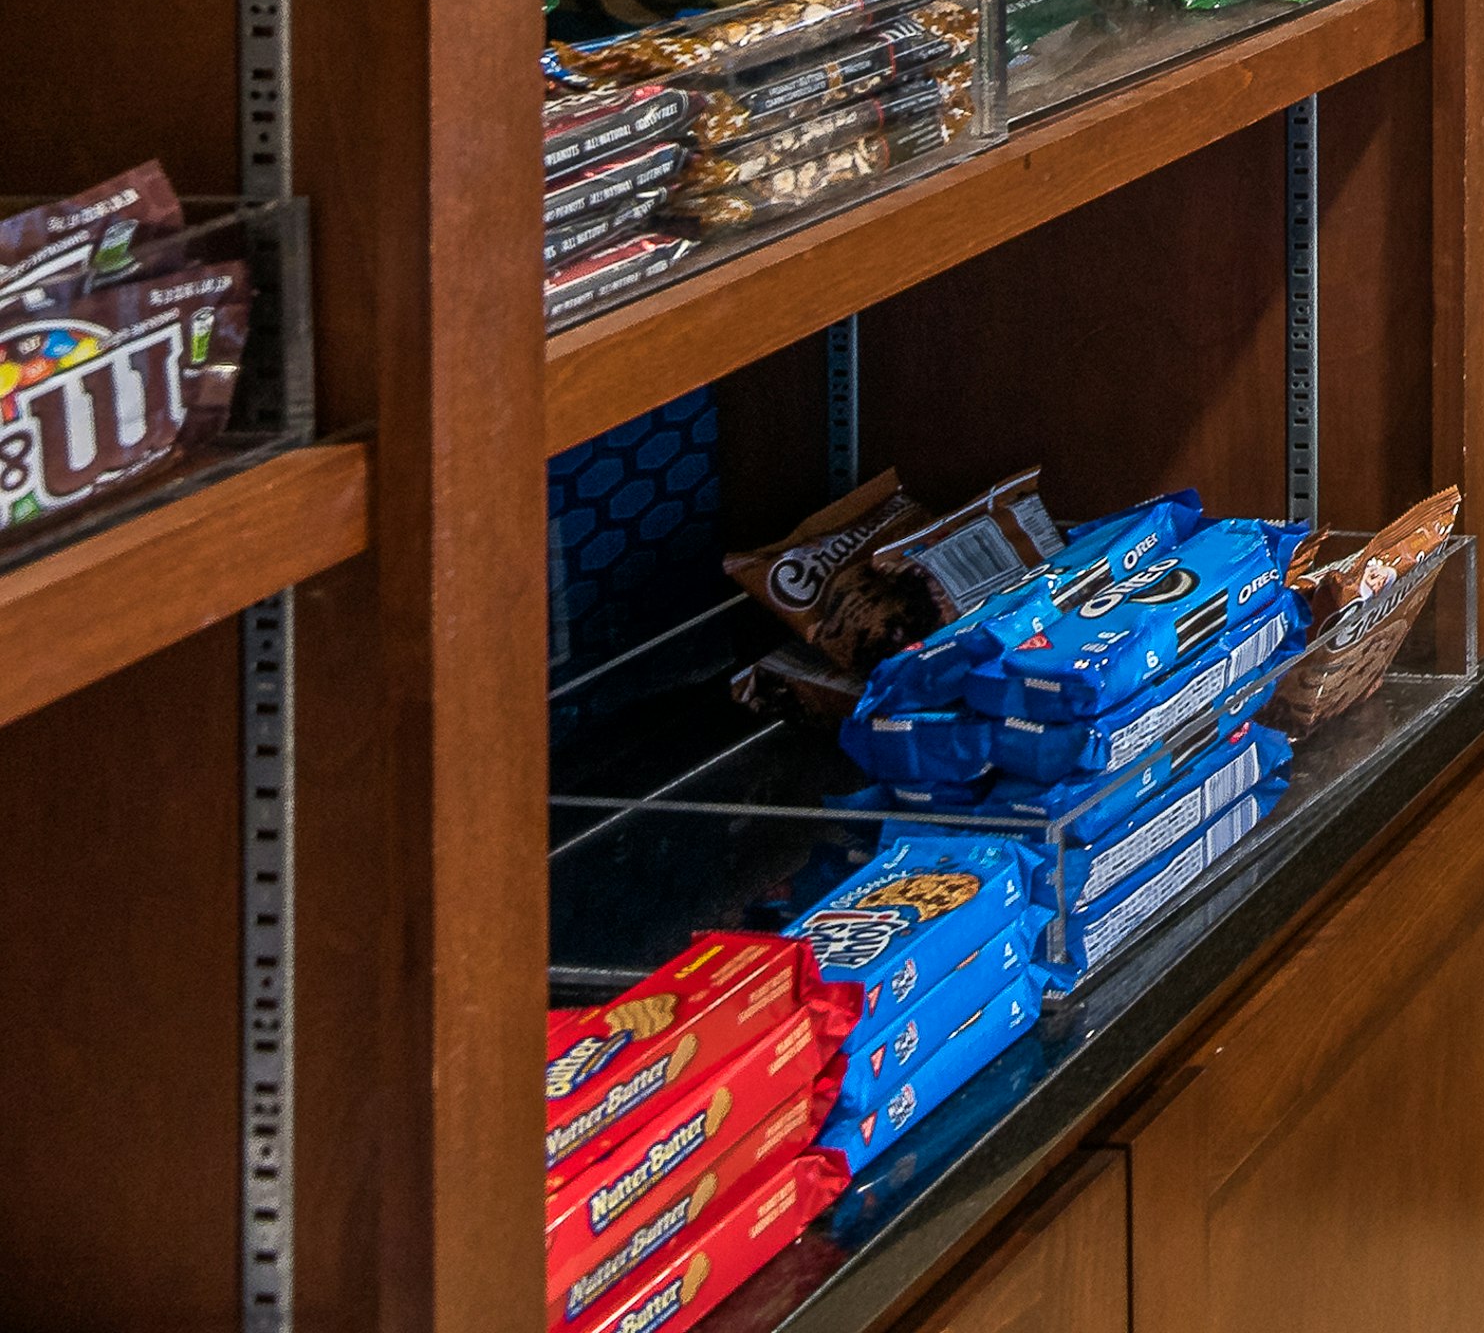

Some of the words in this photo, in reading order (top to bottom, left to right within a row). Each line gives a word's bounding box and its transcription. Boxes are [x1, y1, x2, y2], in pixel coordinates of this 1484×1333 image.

[1079, 555, 1181, 621] OREO
[590, 1162, 651, 1223] Nutter
[647, 1111, 706, 1173] Butter
